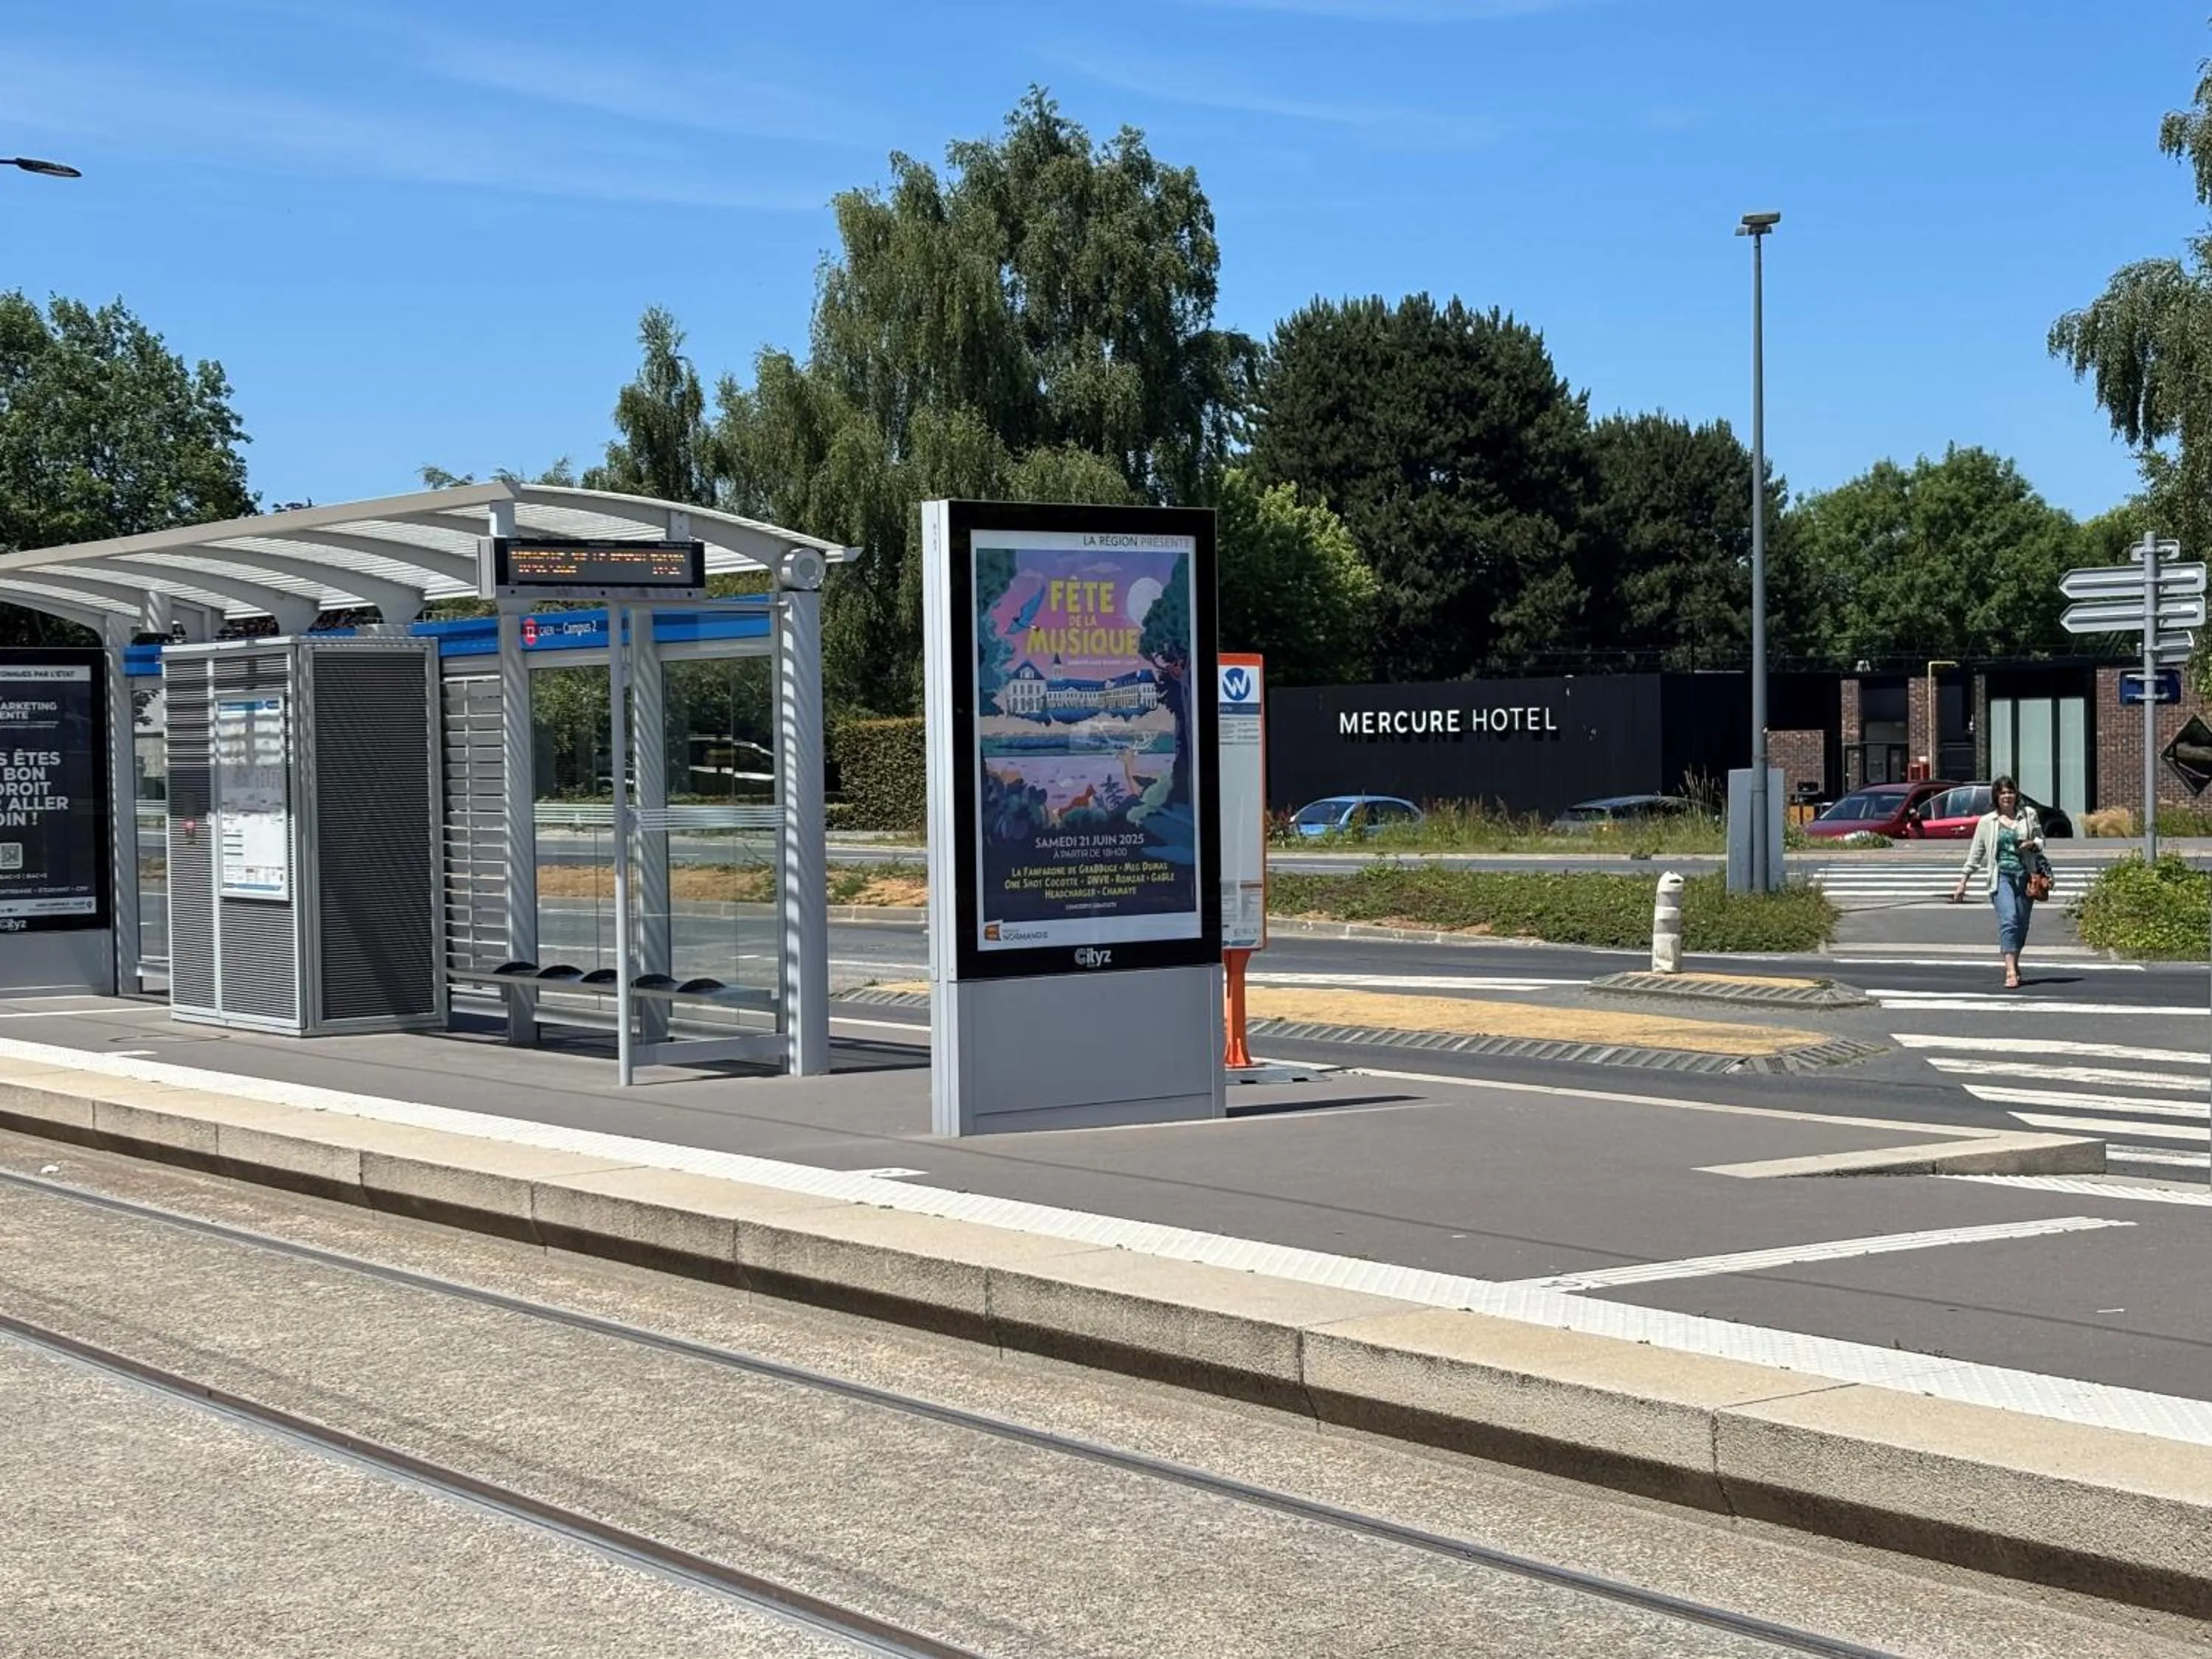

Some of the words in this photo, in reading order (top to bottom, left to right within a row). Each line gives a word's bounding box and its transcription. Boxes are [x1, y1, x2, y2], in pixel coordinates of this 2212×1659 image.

[1083, 535, 1096, 546] LA
[1050, 574, 1115, 613] FÊTE
[1069, 614, 1081, 626] DE
[1084, 615, 1097, 626] LA
[563, 622, 591, 636] Campus
[1026, 627, 1140, 658] MUSIQUE
[1339, 710, 1461, 734] MERCURE
[1472, 707, 1557, 731] HOTEL
[13, 748, 62, 766] ÊTES
[3, 766, 46, 782] BON
[7, 796, 69, 811] ALLER
[32, 812, 38, 826] !
[1034, 836, 1077, 849] SAMEDI
[1079, 835, 1091, 846] 21
[1091, 835, 1117, 846] JUIN
[1119, 833, 1144, 845] 2025
[1090, 849, 1101, 858] DE
